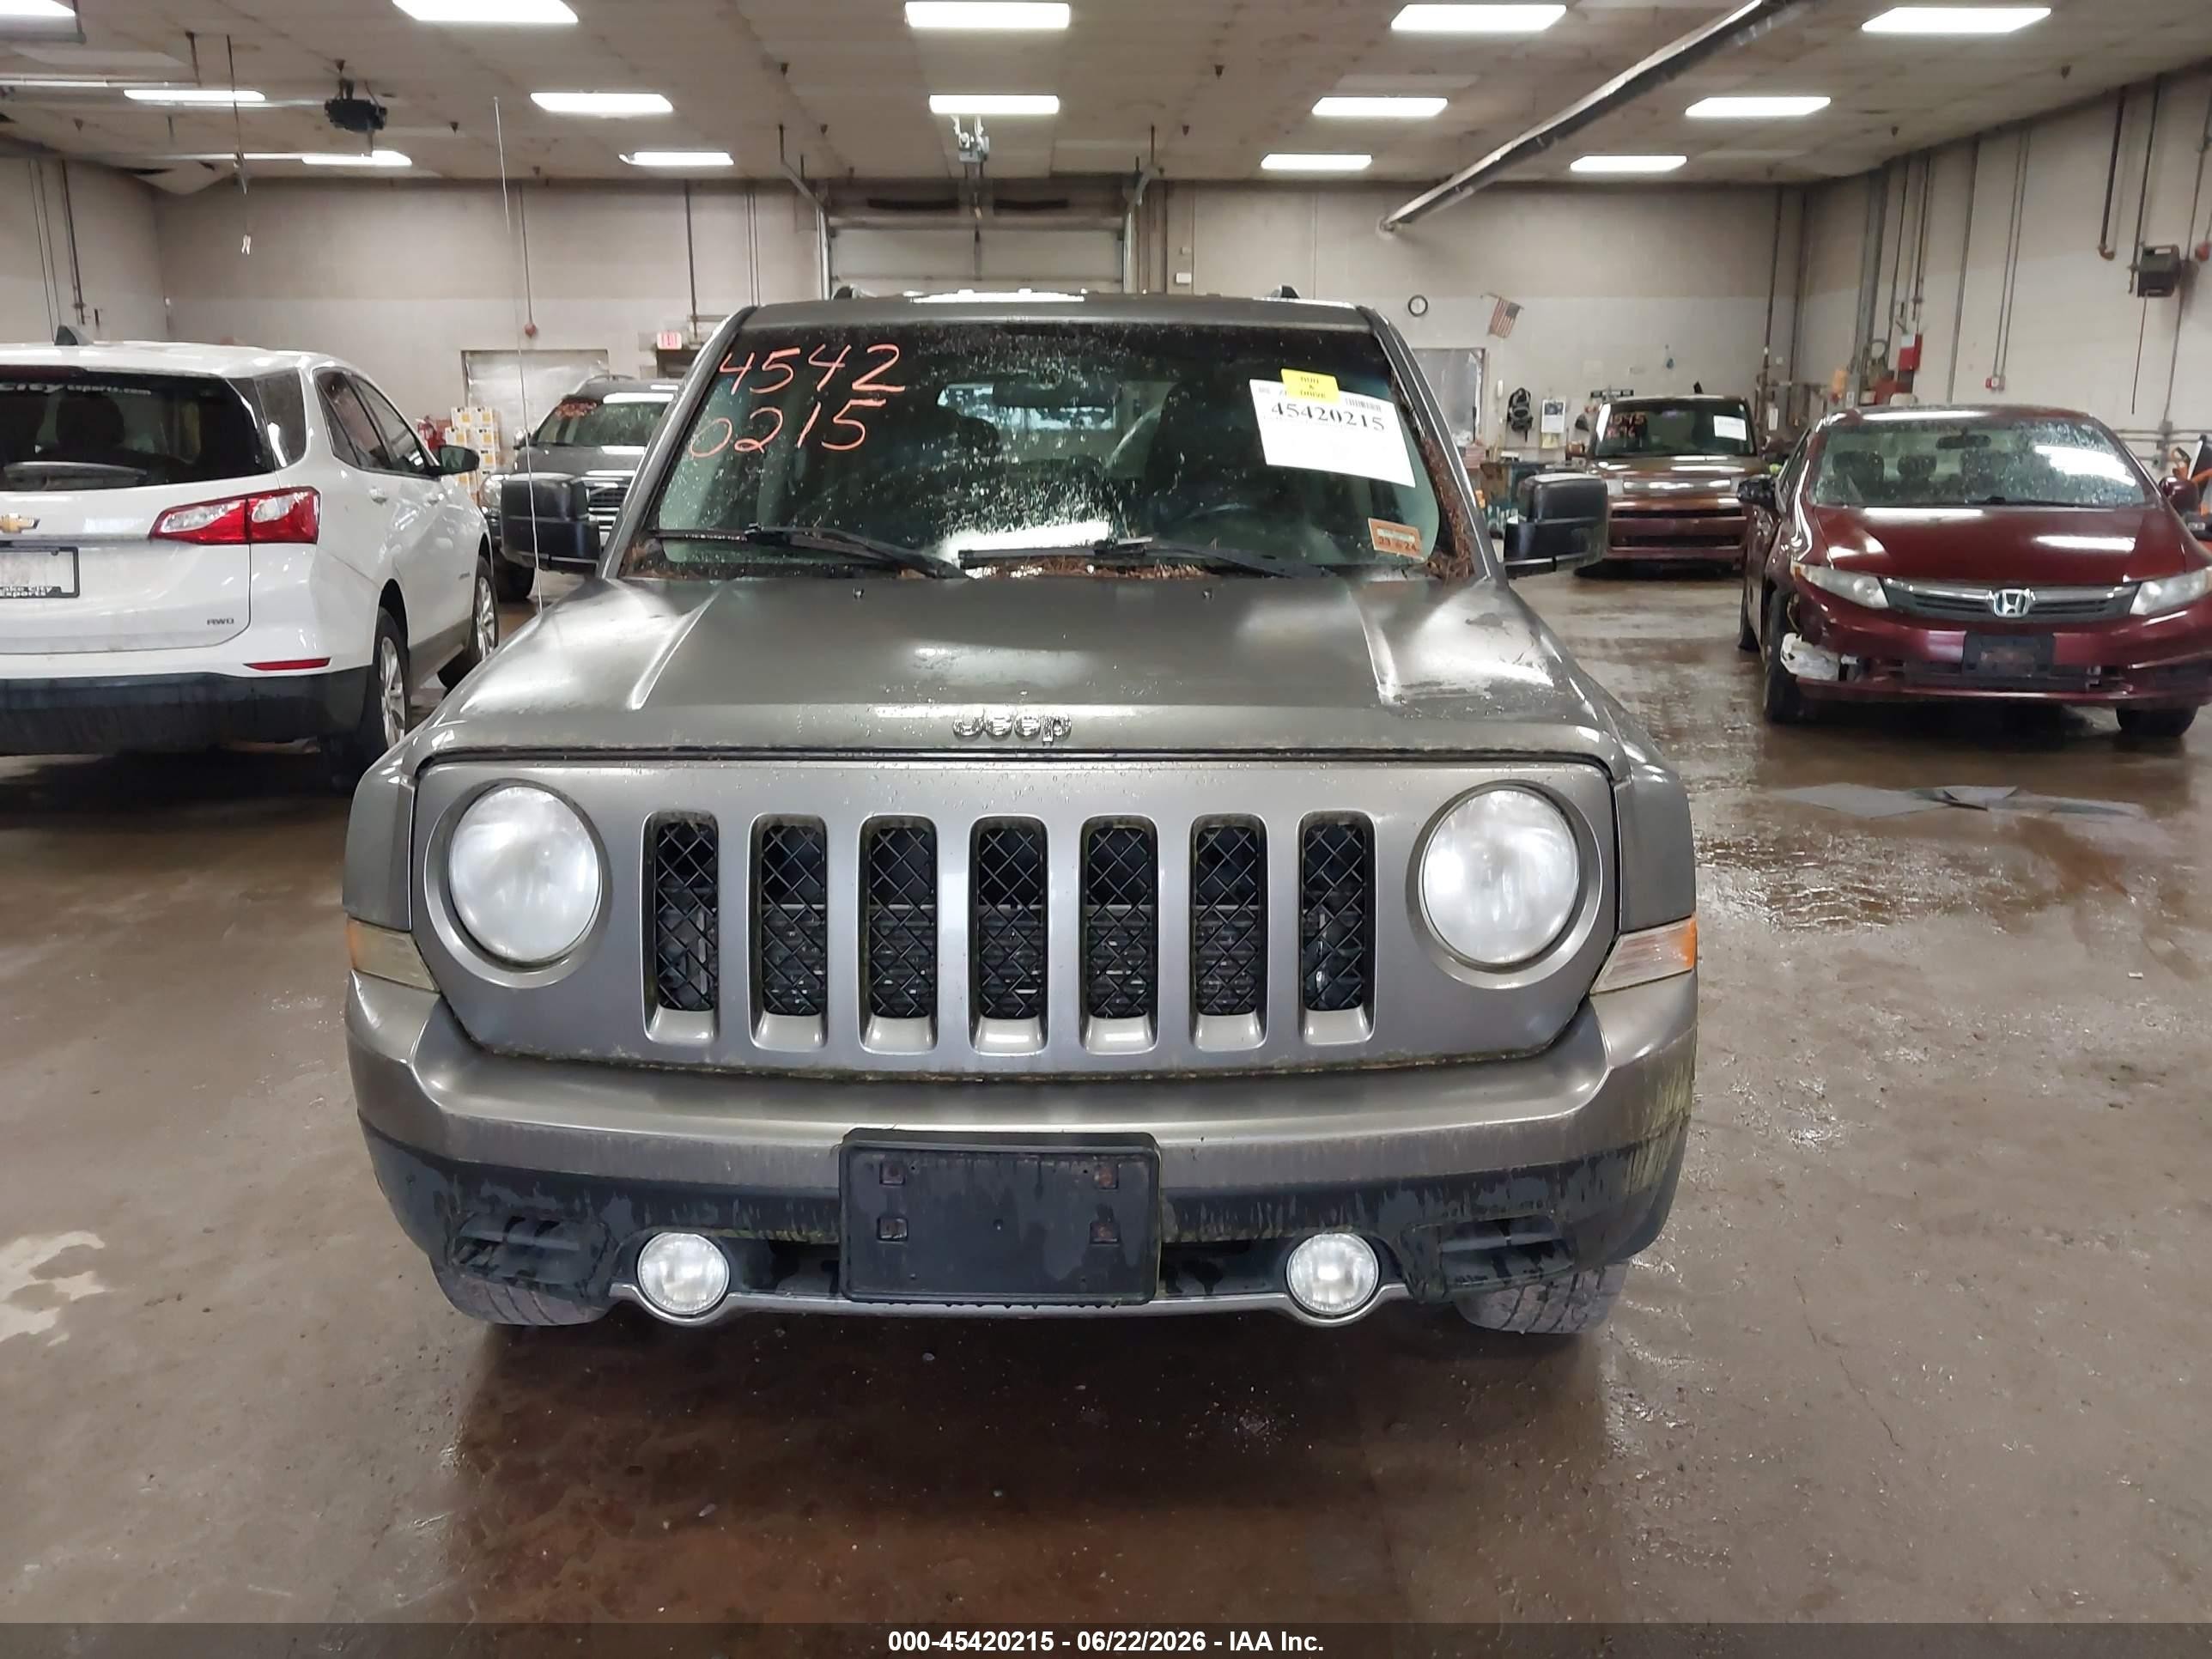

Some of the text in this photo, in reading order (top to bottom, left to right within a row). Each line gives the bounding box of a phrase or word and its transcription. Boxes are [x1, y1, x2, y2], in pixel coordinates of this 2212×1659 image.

[720, 343, 906, 395] 4542
[690, 398, 887, 459] 0215
[1271, 402, 1384, 432] 45420215
[953, 708, 1072, 745] Jeep
